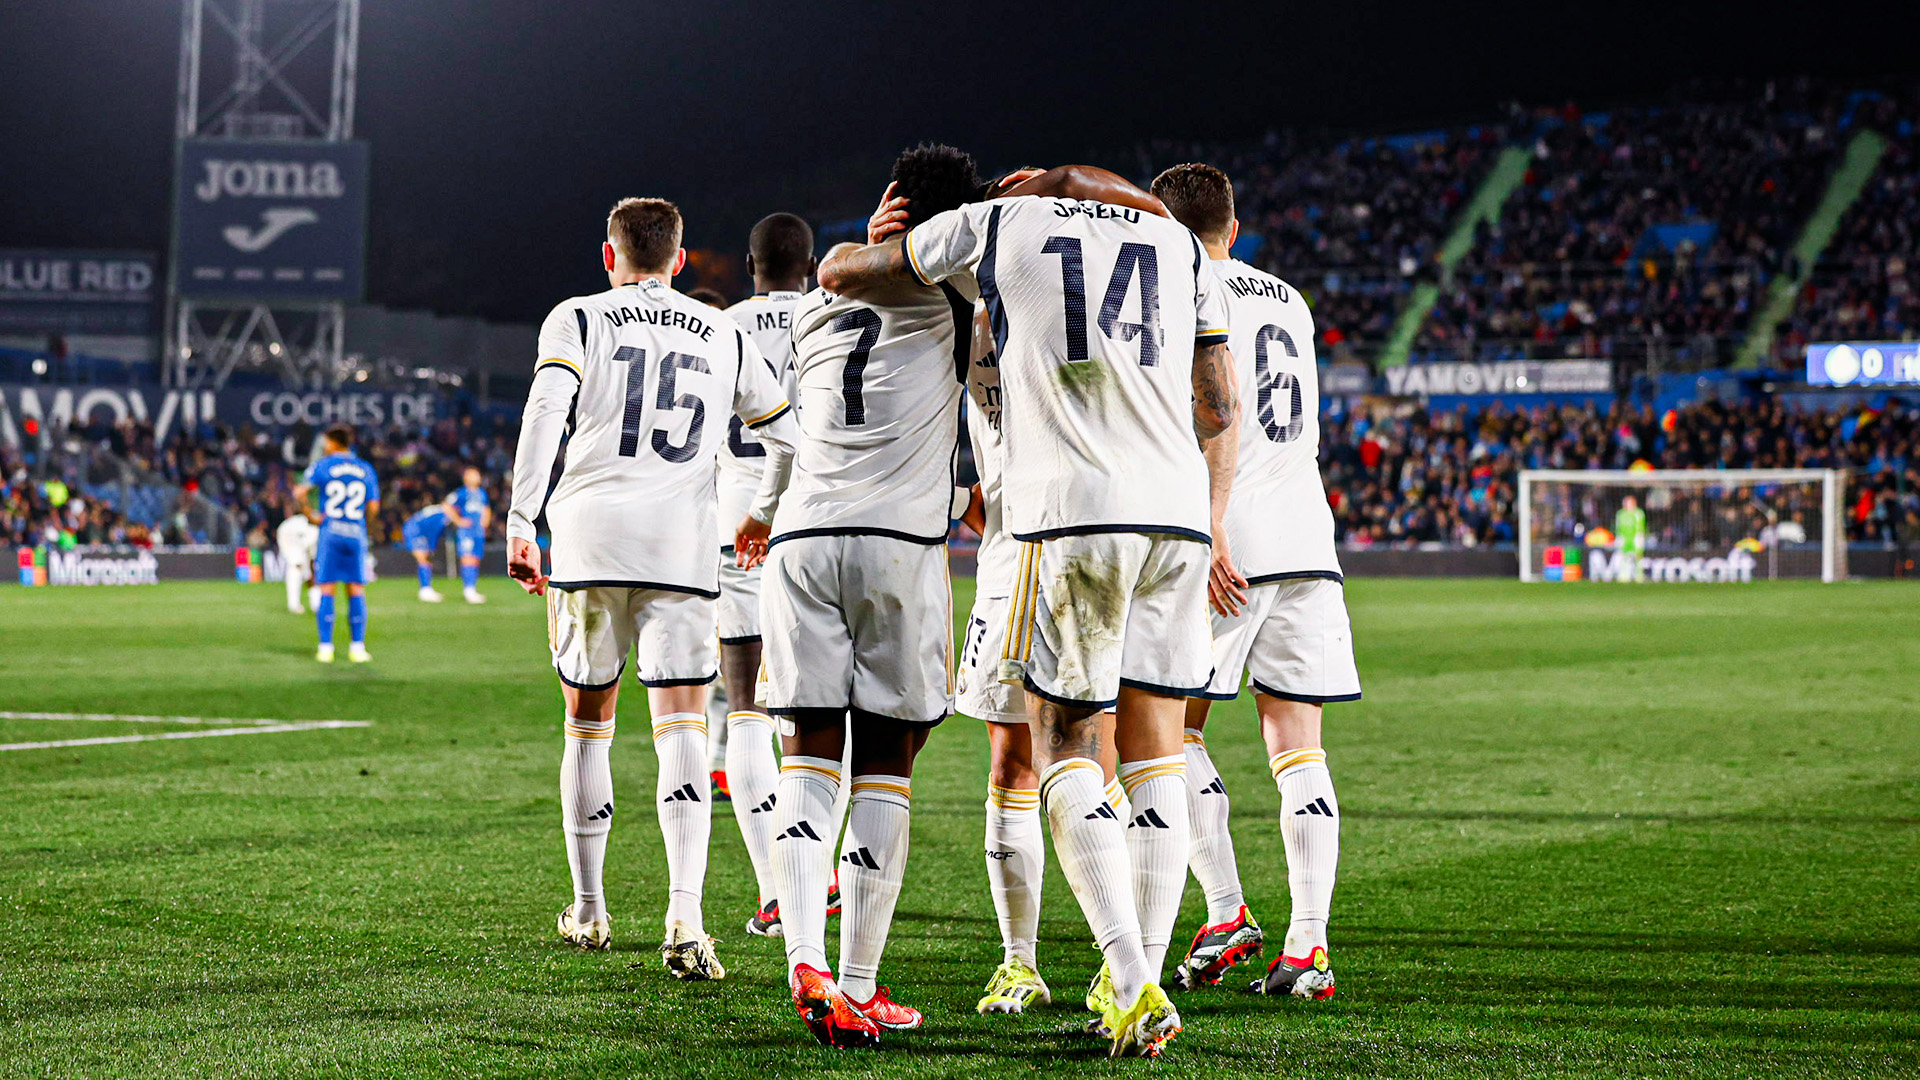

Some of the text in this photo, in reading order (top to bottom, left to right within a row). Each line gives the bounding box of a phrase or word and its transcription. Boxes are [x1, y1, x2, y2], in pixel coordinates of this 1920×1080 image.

[0, 260, 152, 291] LUE RED
[1225, 277, 1289, 304] NACHO
[1040, 235, 1165, 368] 14
[604, 306, 715, 343] VALVERDE
[756, 311, 793, 332] ME
[828, 307, 882, 426] 7
[1862, 348, 1883, 378] 0
[1255, 323, 1302, 443] 6
[251, 392, 384, 426] COCHES
[612, 345, 712, 463] 15
[325, 480, 367, 520] 22
[985, 850, 1016, 861] MCF
